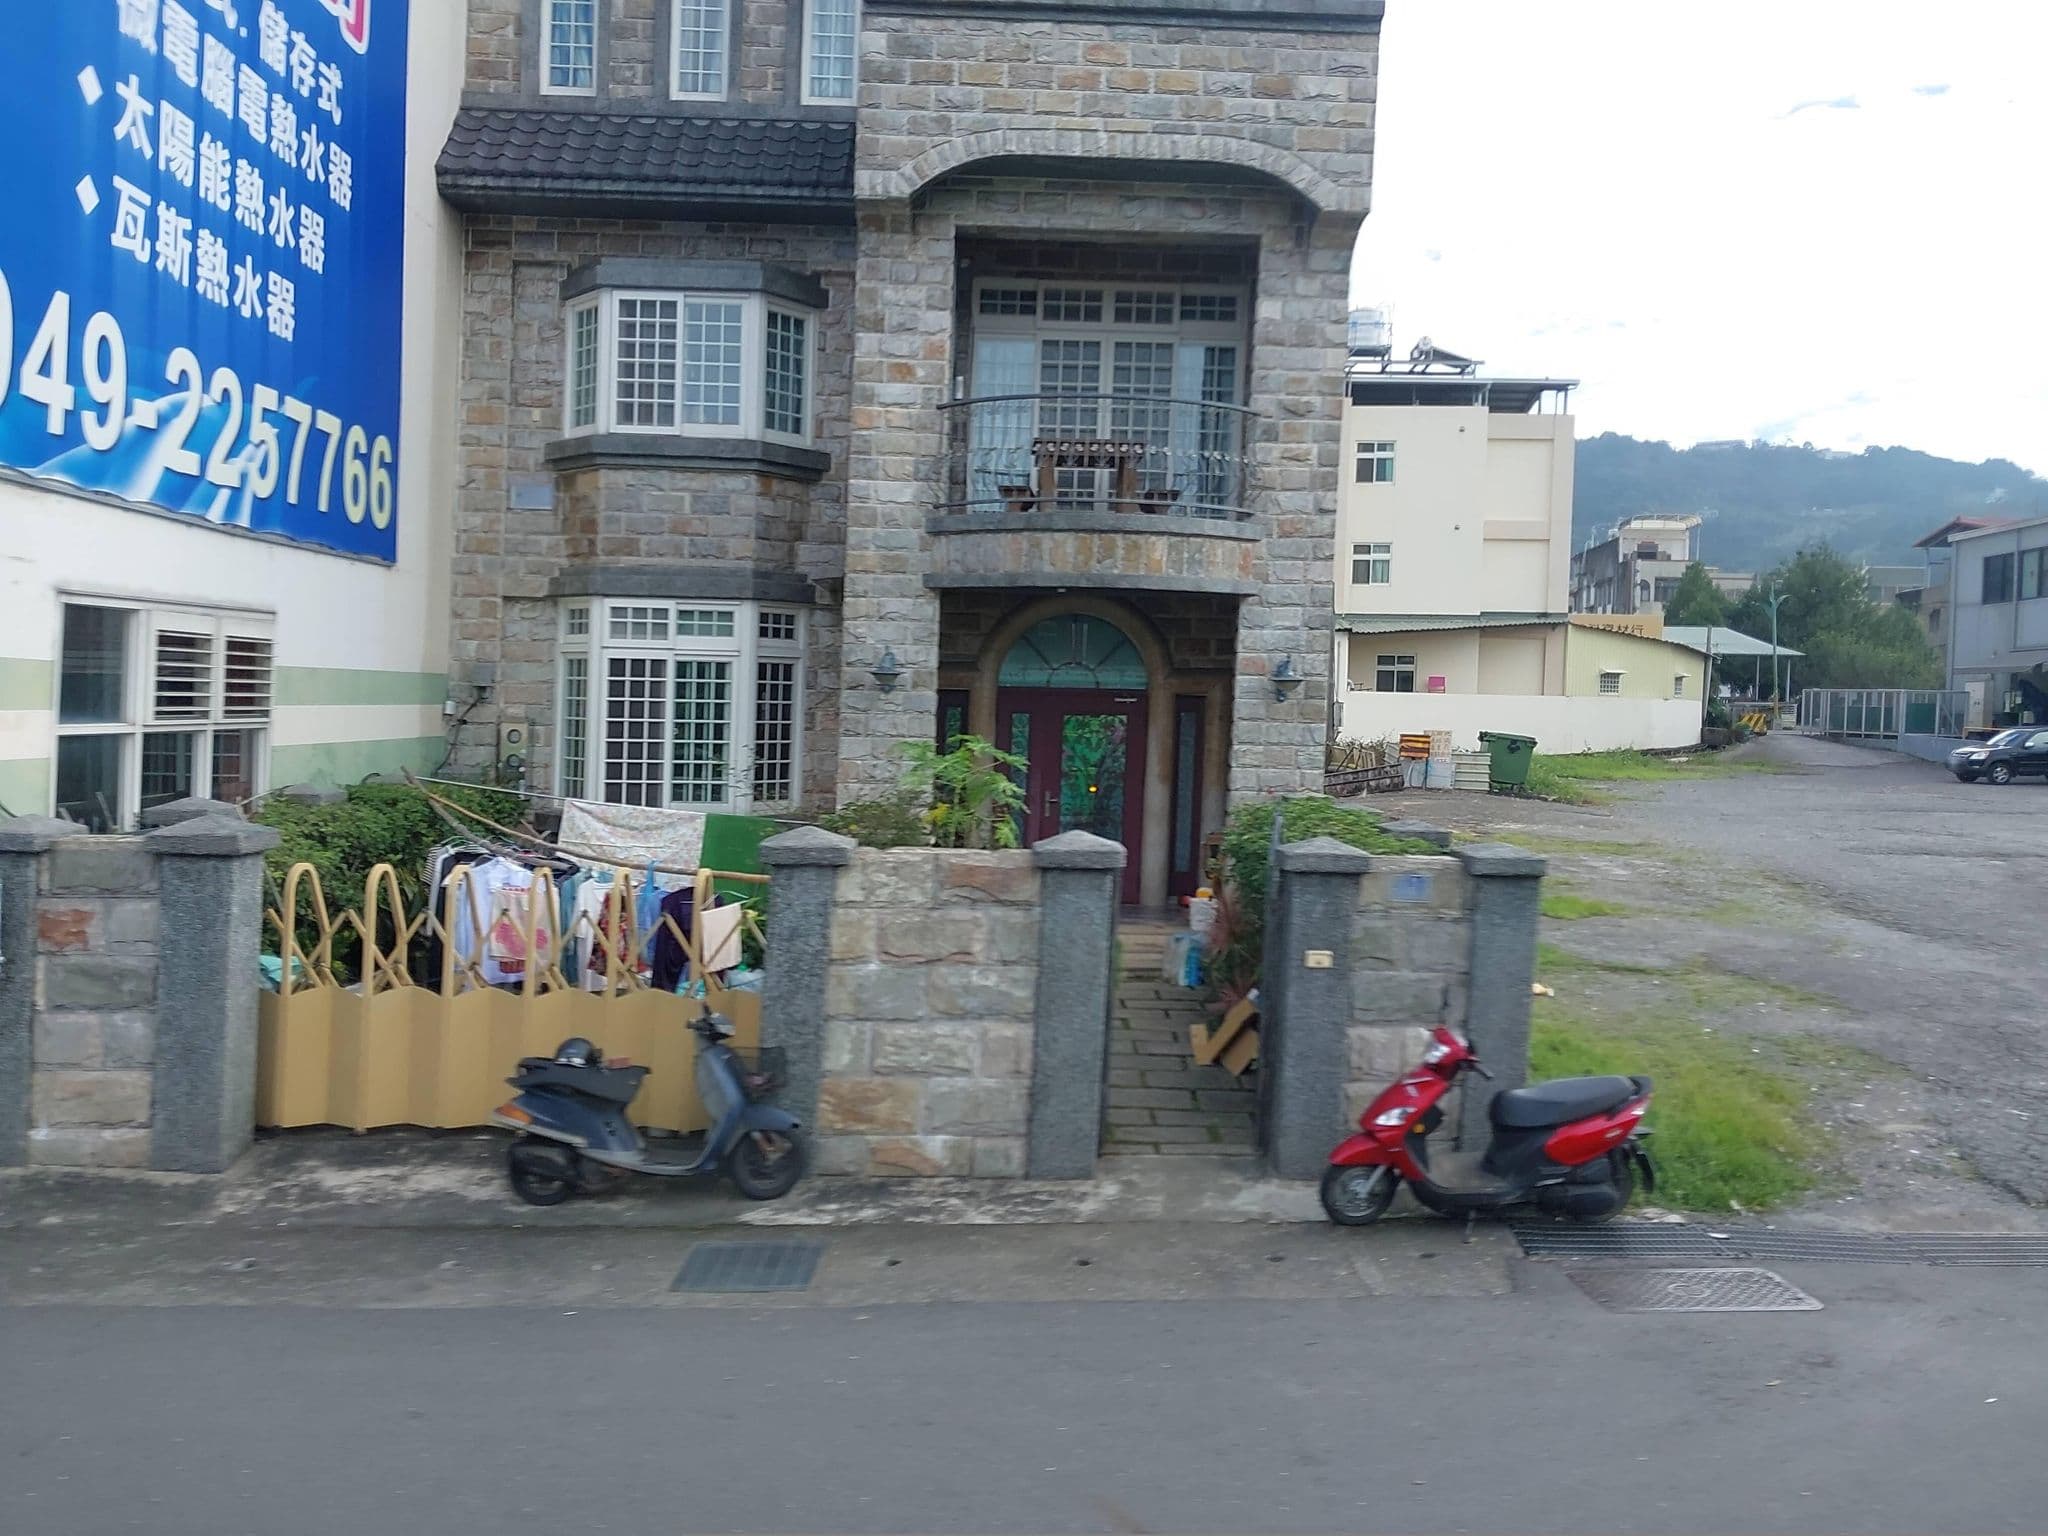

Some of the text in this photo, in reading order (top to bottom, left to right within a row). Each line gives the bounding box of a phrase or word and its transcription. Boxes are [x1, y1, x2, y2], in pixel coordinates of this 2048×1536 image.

[110, 174, 297, 342] 瓦斯熱水器
[113, 73, 326, 275] 太陽能熱水器
